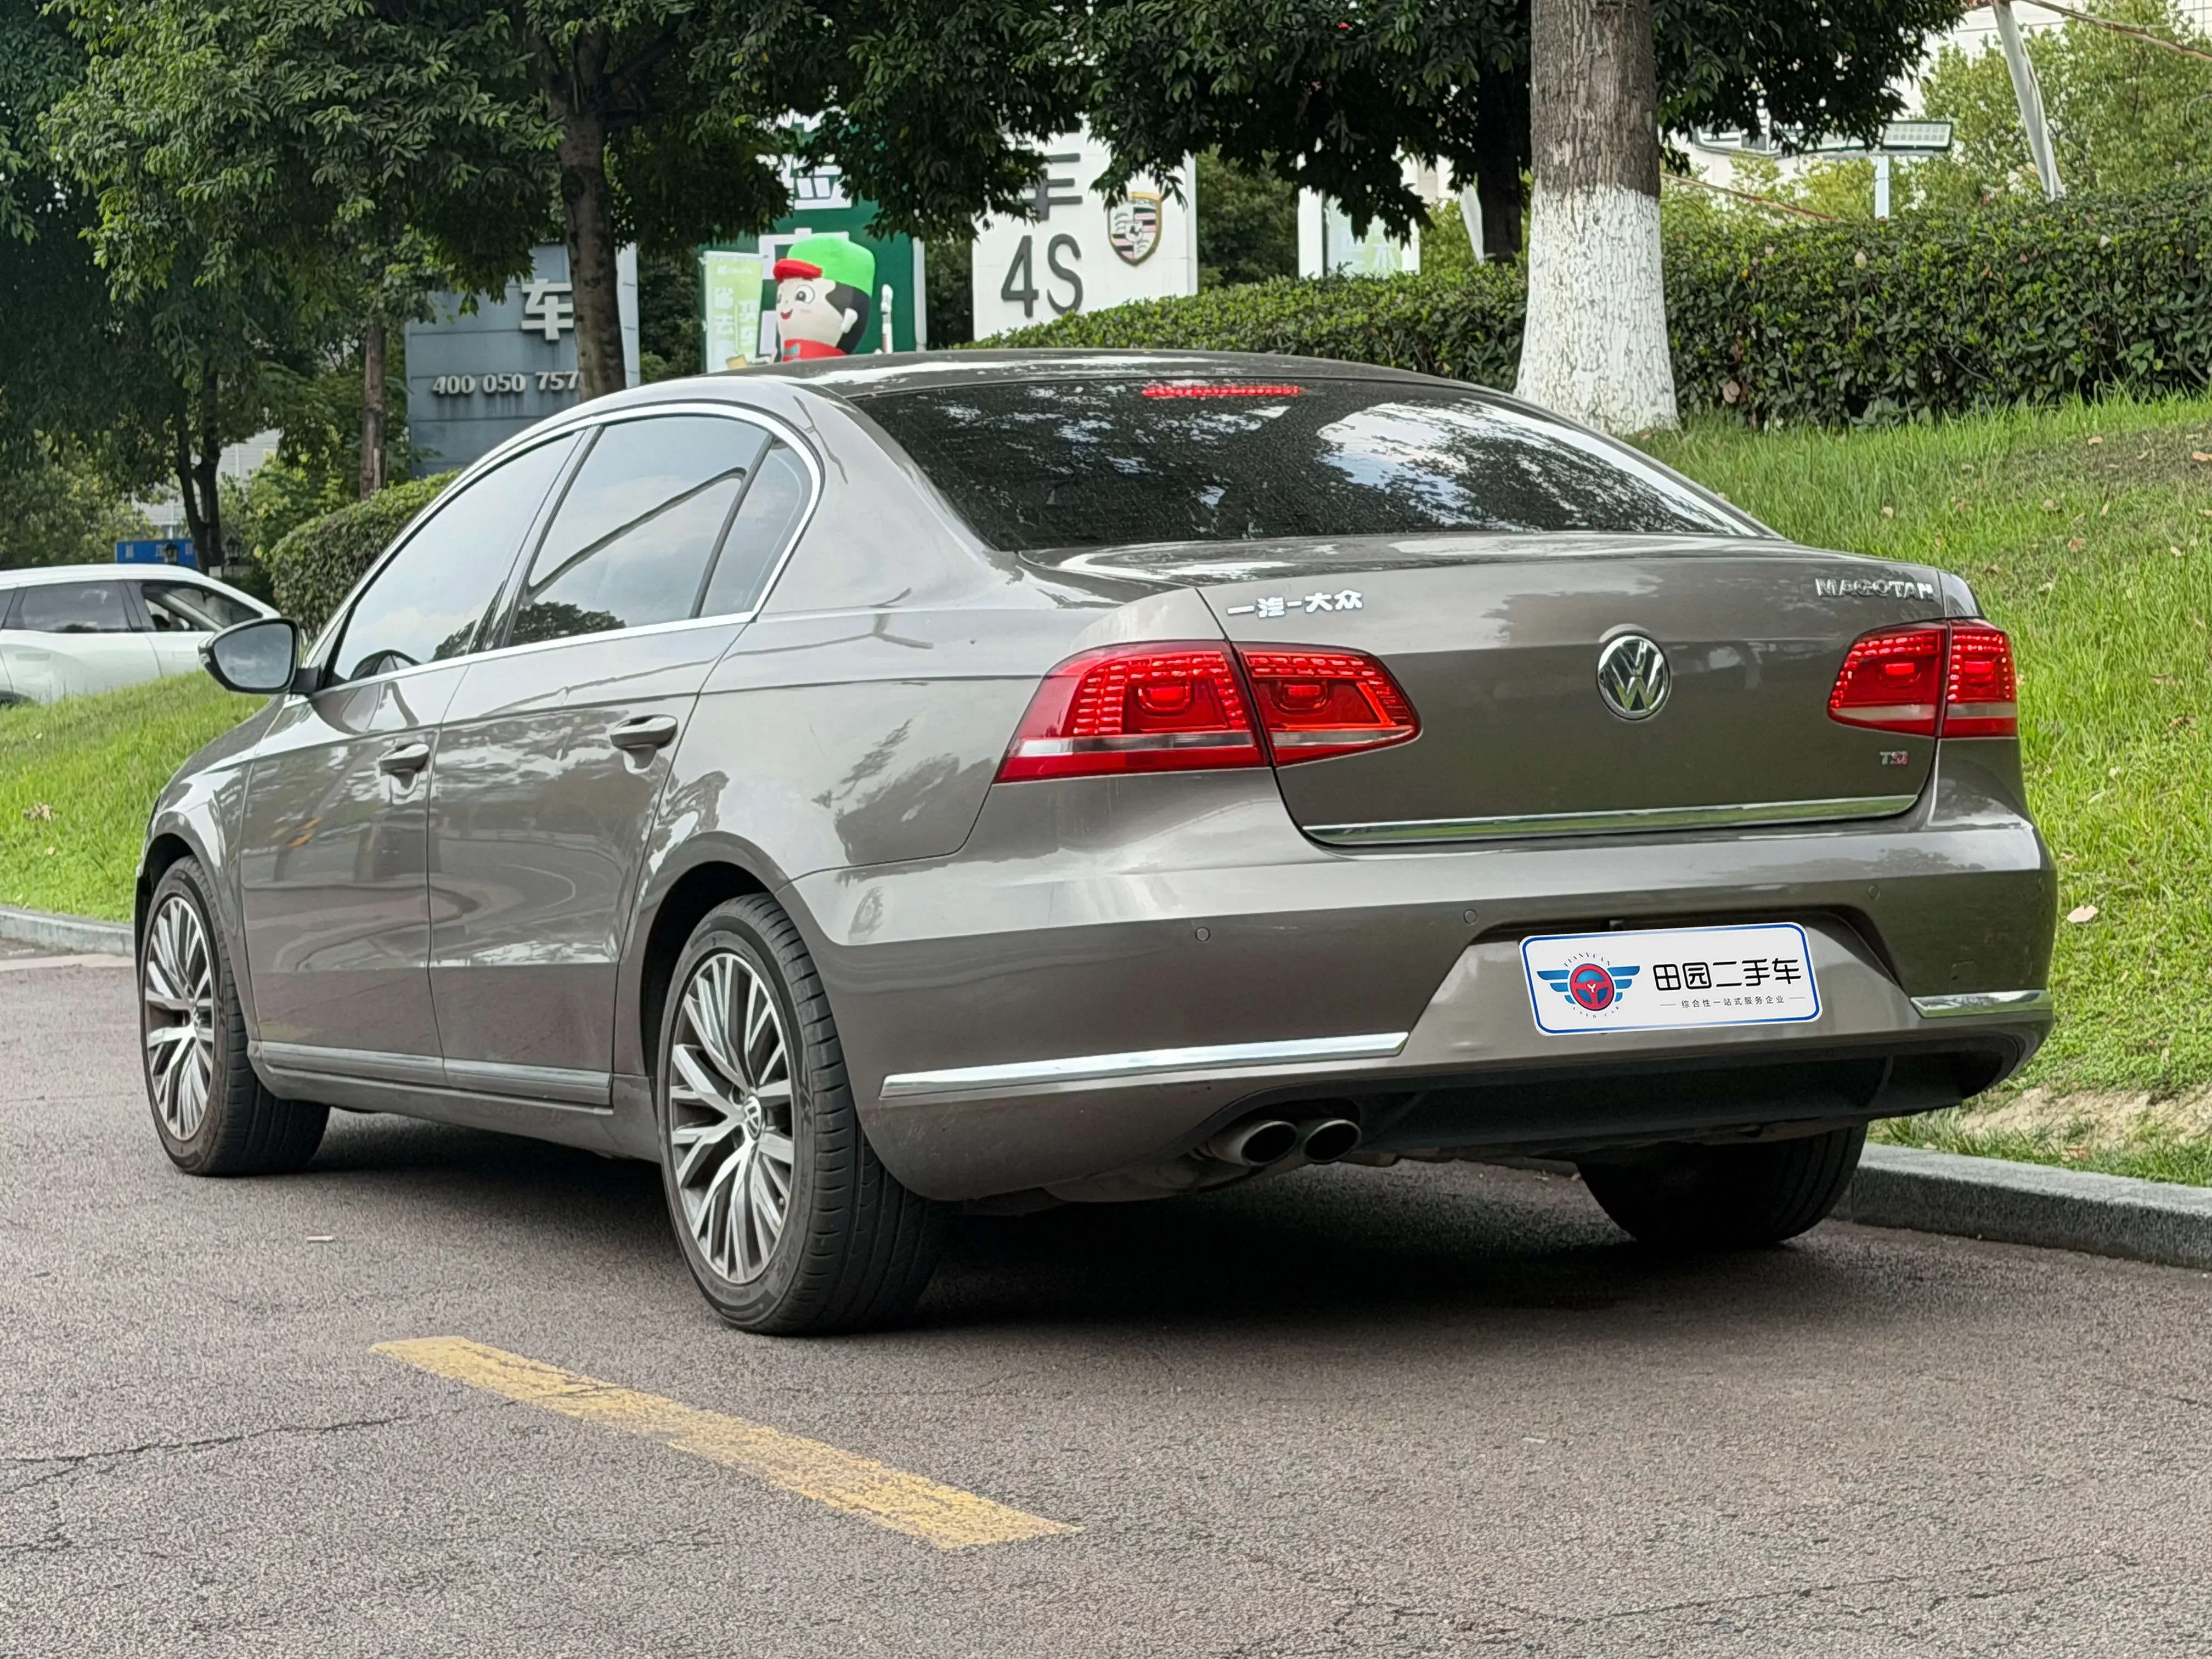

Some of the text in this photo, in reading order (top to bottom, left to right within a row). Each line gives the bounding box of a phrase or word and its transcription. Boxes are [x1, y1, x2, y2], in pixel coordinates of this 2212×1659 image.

[1001, 233, 1084, 318] 4S
[521, 278, 574, 340] 车
[432, 370, 579, 394] 400 050 757
[1227, 589, 1363, 618] 一汽-大众
[1815, 578, 1934, 600] MAGOTAN
